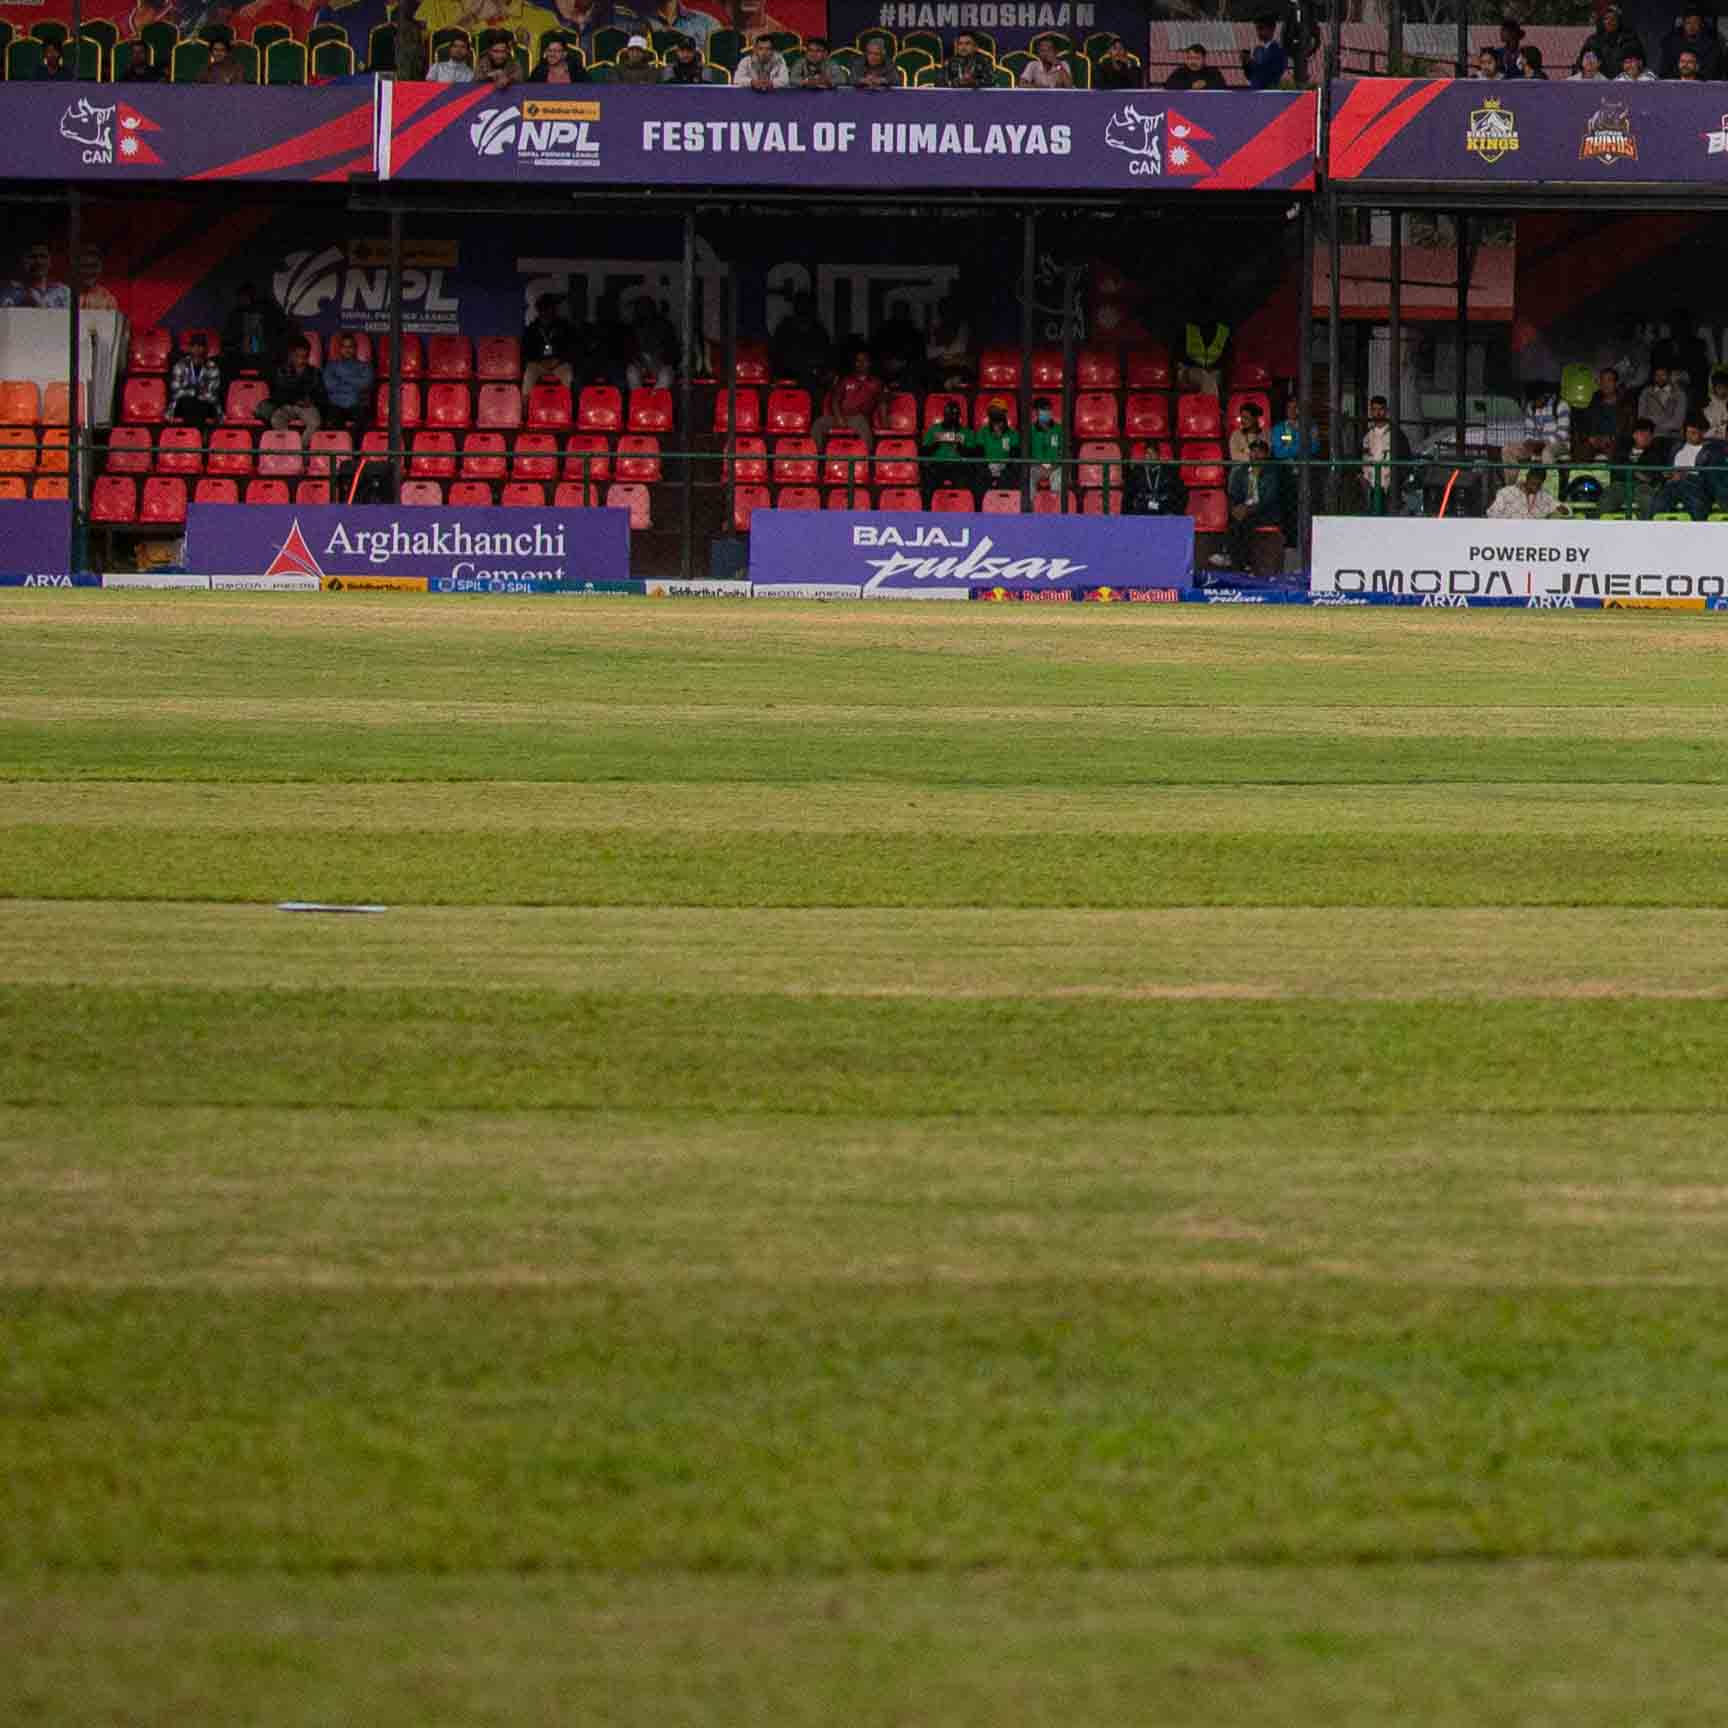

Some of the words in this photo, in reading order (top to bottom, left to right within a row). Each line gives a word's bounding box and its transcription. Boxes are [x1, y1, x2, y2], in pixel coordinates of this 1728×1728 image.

[517, 120, 601, 152] NPL
[642, 120, 807, 152] FESTIVAL
[813, 122, 857, 153] OF
[871, 123, 1072, 155] HIMALAYAS
[1466, 136, 1521, 153] KINGS
[1582, 135, 1636, 157] RHINOS
[82, 149, 114, 165] CAN
[1128, 160, 1161, 176] CAN
[325, 522, 567, 563] Arghakhanchi
[853, 526, 970, 548] BAJAJ
[1469, 546, 1561, 562] POWERED
[1565, 548, 1591, 563] BY
[23, 574, 73, 588] ARYA
[457, 576, 482, 592] SPIL
[506, 578, 532, 593] SPIL
[1334, 569, 1512, 595] OMODA
[1546, 573, 1725, 596] JAECOO
[1420, 593, 1470, 608] ARYA
[1526, 596, 1576, 609] ARYA
